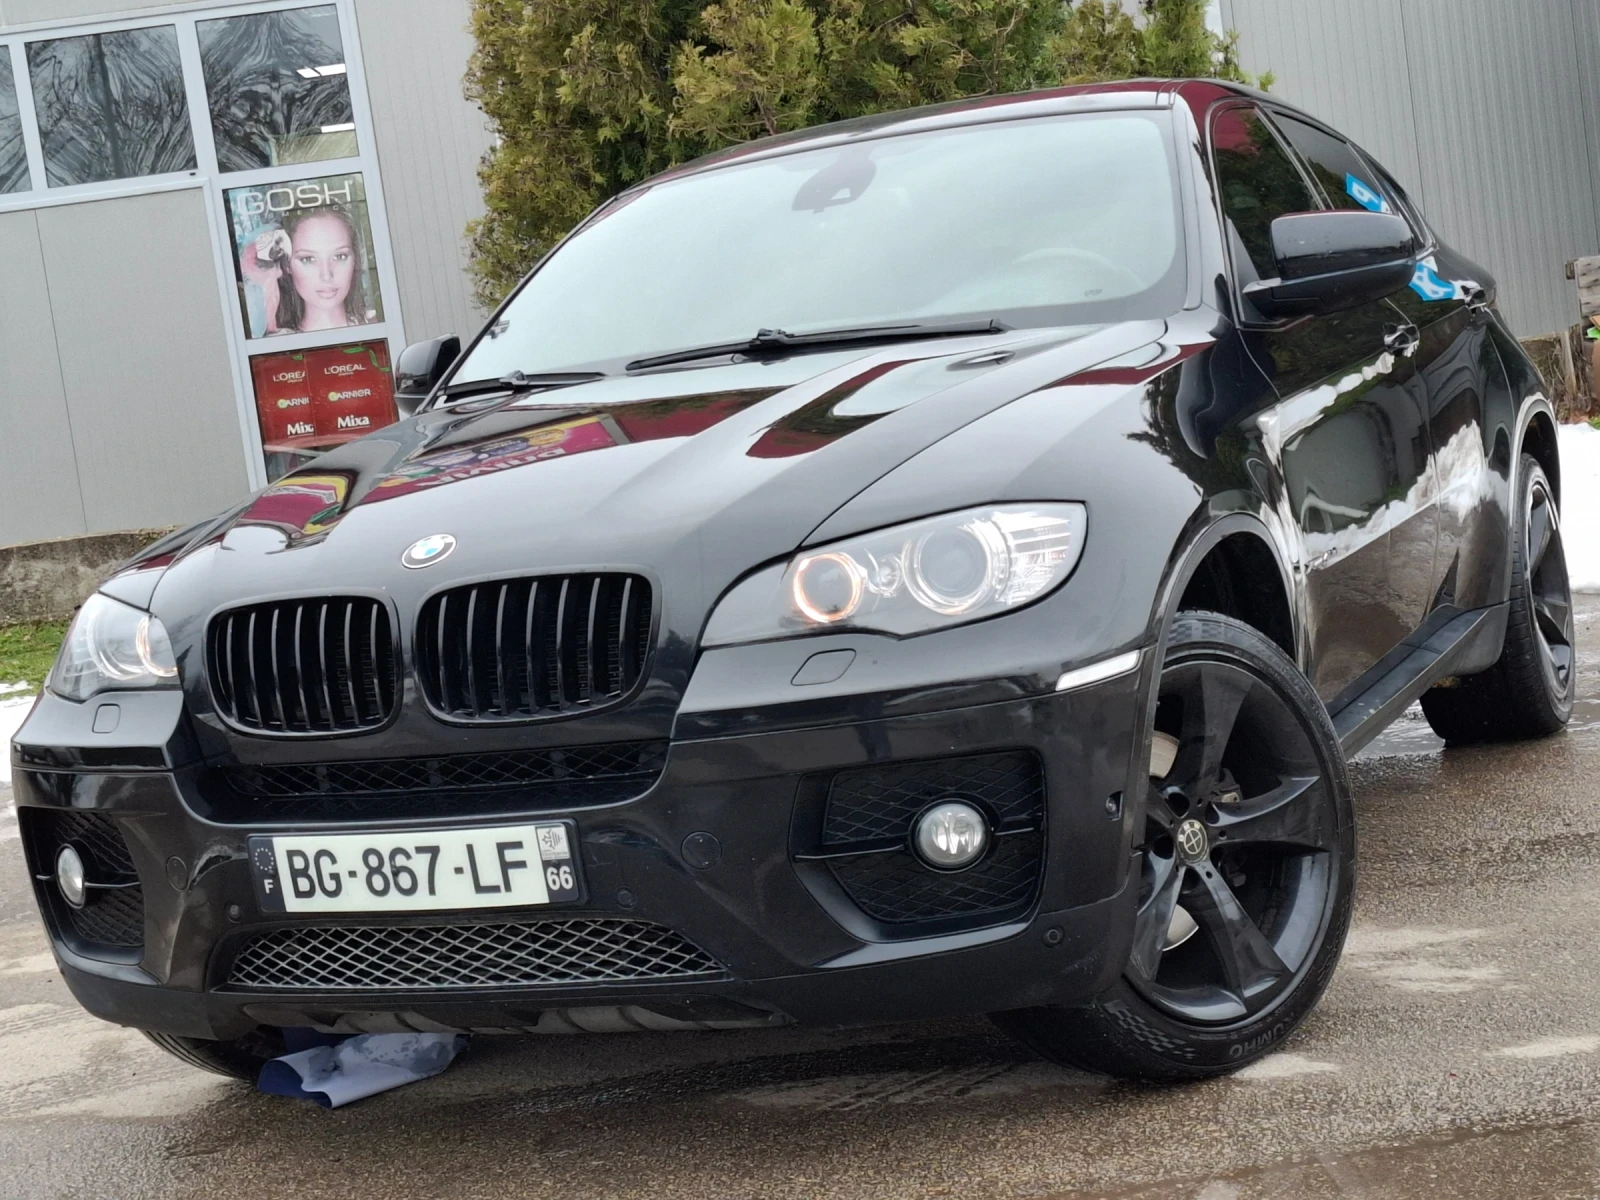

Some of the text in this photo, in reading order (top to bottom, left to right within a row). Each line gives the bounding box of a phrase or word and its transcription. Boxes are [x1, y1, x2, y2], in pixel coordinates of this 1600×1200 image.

[236, 180, 352, 215] GOSH
[240, 203, 353, 223] OSMETICS
[328, 388, 371, 402] GARNIER
[337, 414, 370, 429] Mixa
[285, 841, 528, 899] BG-867-LF
[546, 865, 574, 891] 66
[264, 880, 274, 894] F
